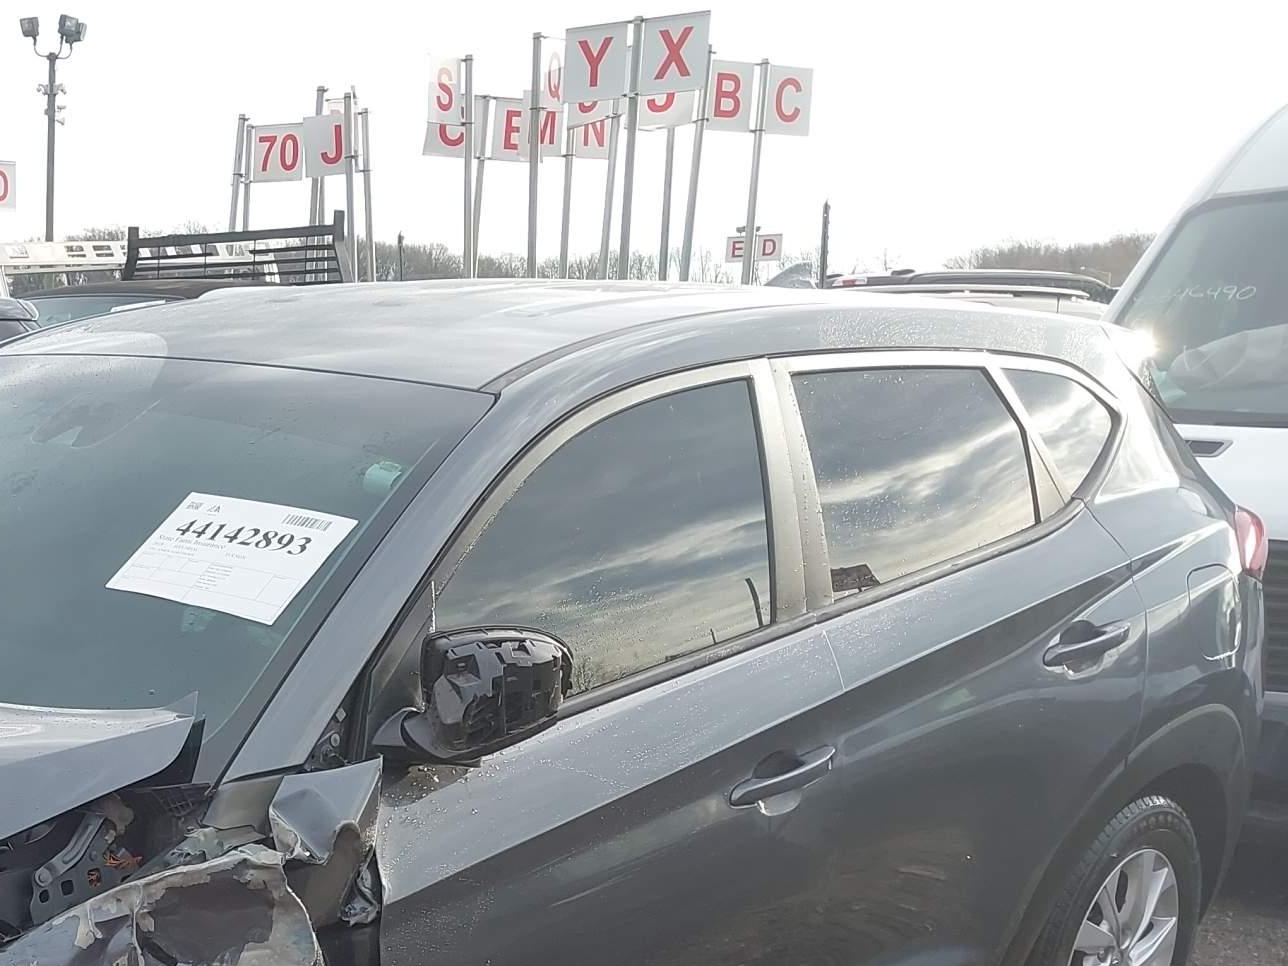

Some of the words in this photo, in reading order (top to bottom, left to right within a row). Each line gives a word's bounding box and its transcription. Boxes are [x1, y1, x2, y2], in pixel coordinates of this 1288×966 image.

[578, 36, 613, 87] Y
[654, 26, 694, 80] X
[436, 67, 453, 111] S
[713, 72, 741, 118] B
[775, 77, 802, 123] C
[320, 124, 342, 165] J
[503, 110, 522, 150] E
[258, 133, 299, 172] 70
[731, 240, 745, 258] E
[761, 238, 777, 257] D
[175, 519, 312, 556] 44142893
